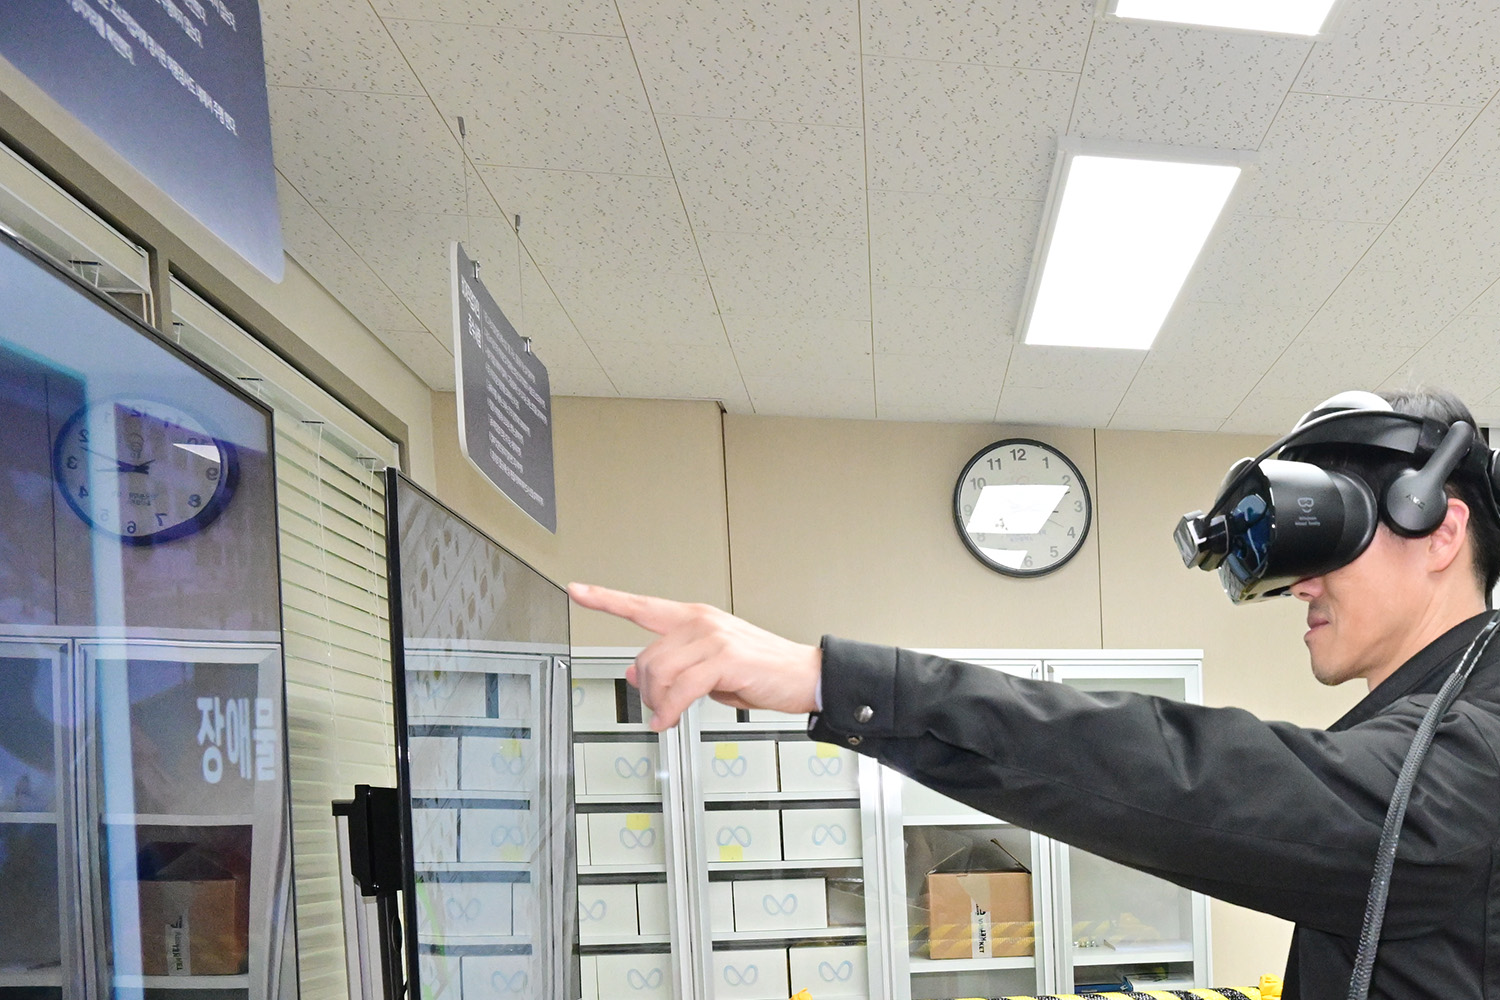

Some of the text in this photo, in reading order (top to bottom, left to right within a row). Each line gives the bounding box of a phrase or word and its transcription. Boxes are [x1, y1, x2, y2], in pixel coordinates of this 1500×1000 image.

[1010, 448, 1027, 461] 12
[987, 458, 1002, 470] 11
[1042, 457, 1049, 469] 1
[970, 477, 986, 490] 10
[1062, 475, 1071, 487] 2
[1074, 500, 1083, 512] 3
[1067, 527, 1076, 539] 4
[1050, 546, 1059, 557] 5
[1024, 556, 1033, 567] 6
[196, 697, 277, 784] 장애물
